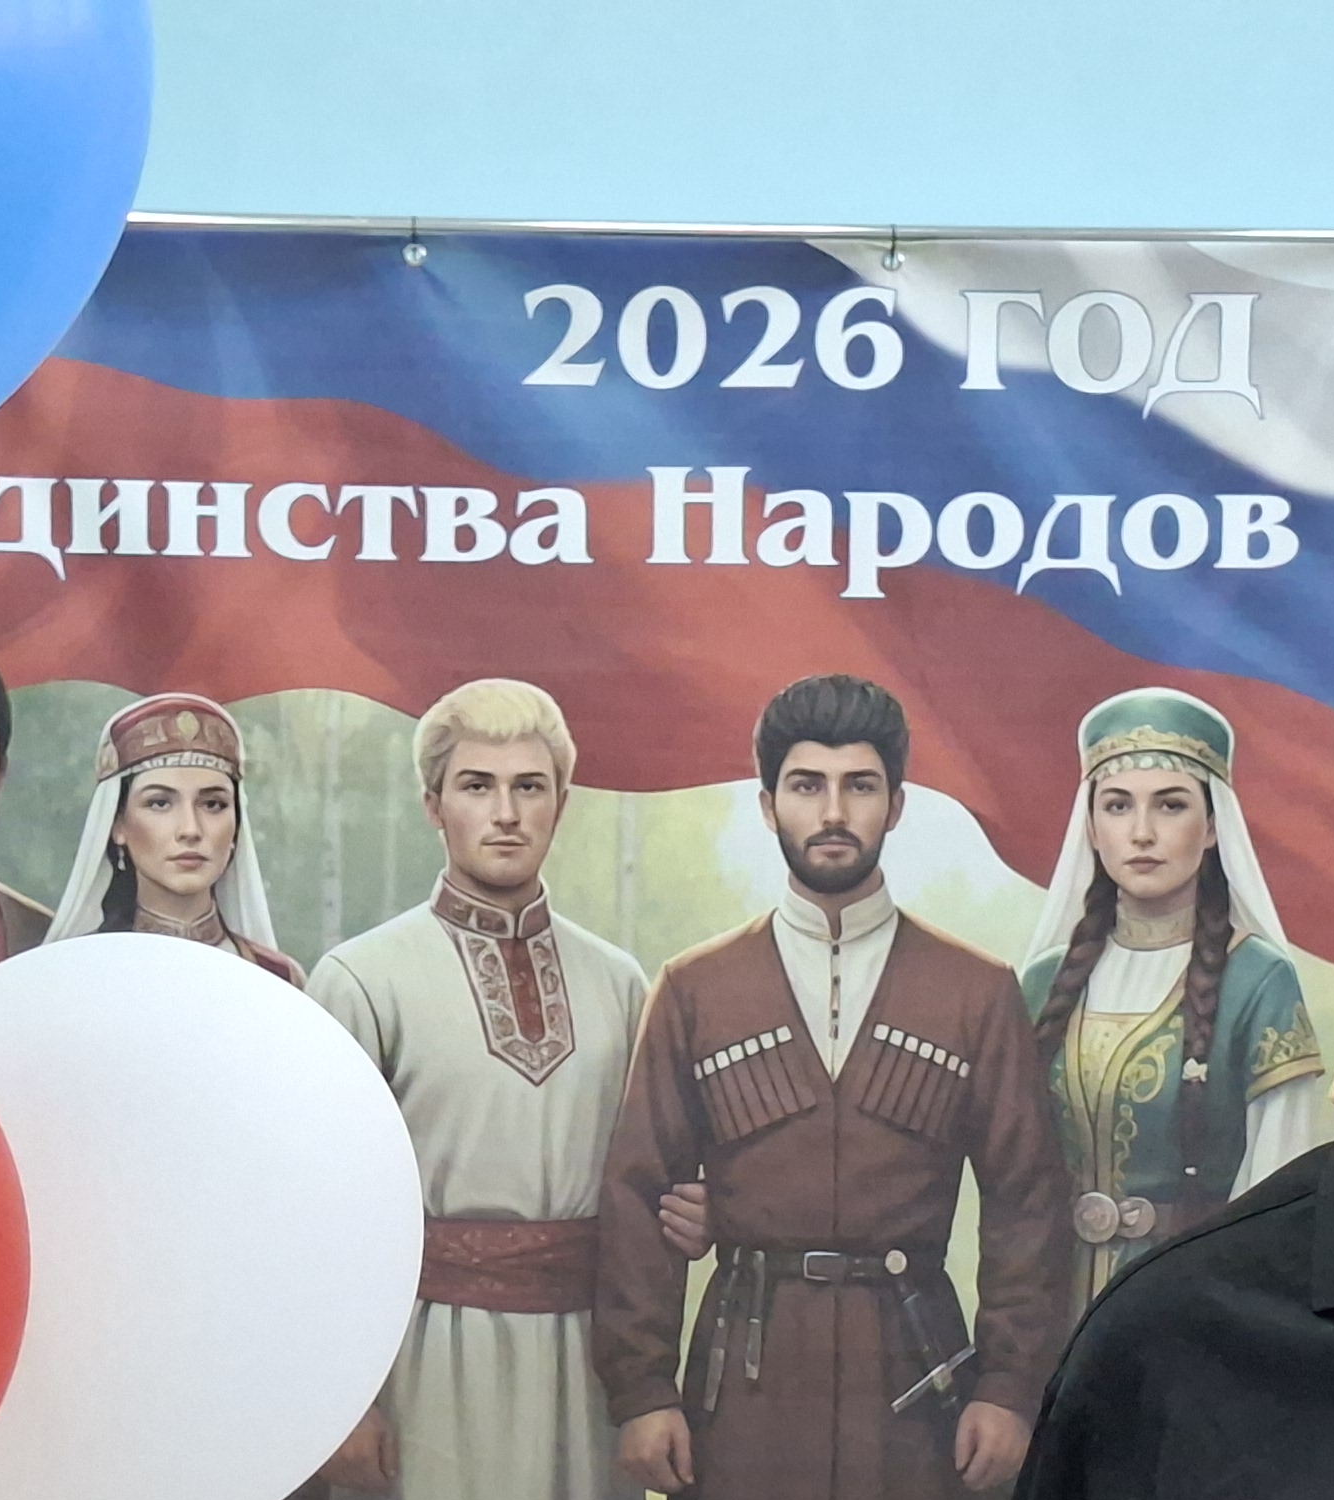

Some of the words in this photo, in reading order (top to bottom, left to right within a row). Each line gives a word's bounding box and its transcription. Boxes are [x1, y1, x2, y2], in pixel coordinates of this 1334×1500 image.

[521, 283, 905, 391] 2026
[959, 288, 1265, 421] ГОД
[644, 465, 1302, 600] Народов
